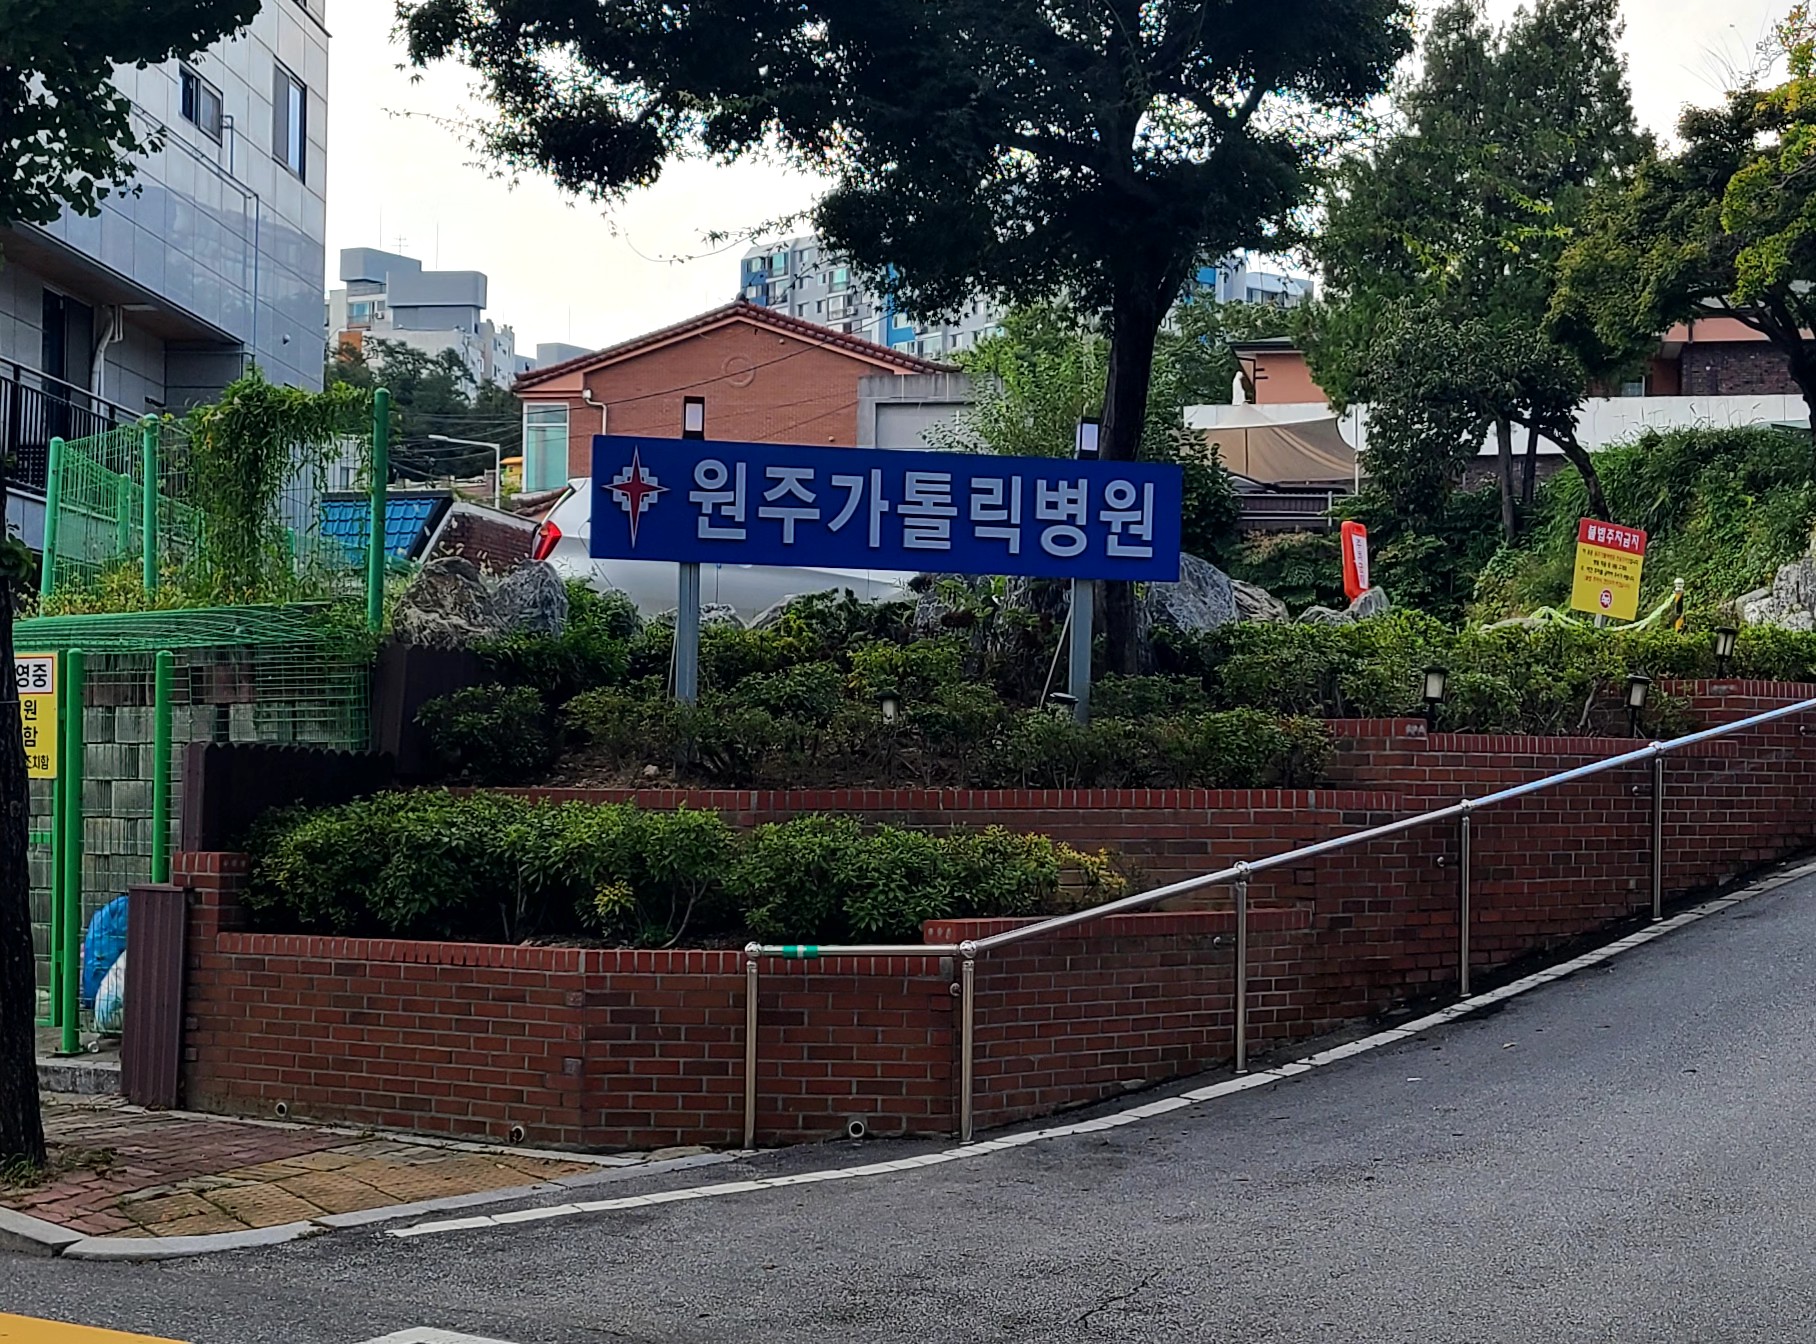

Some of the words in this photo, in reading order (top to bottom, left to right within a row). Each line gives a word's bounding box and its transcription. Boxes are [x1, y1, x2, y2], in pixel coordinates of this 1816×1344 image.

[688, 458, 1154, 559] 원주가톨릭병원
[1587, 524, 1640, 551] 불법주차금지
[23, 699, 38, 721] 원
[23, 726, 39, 748] 함
